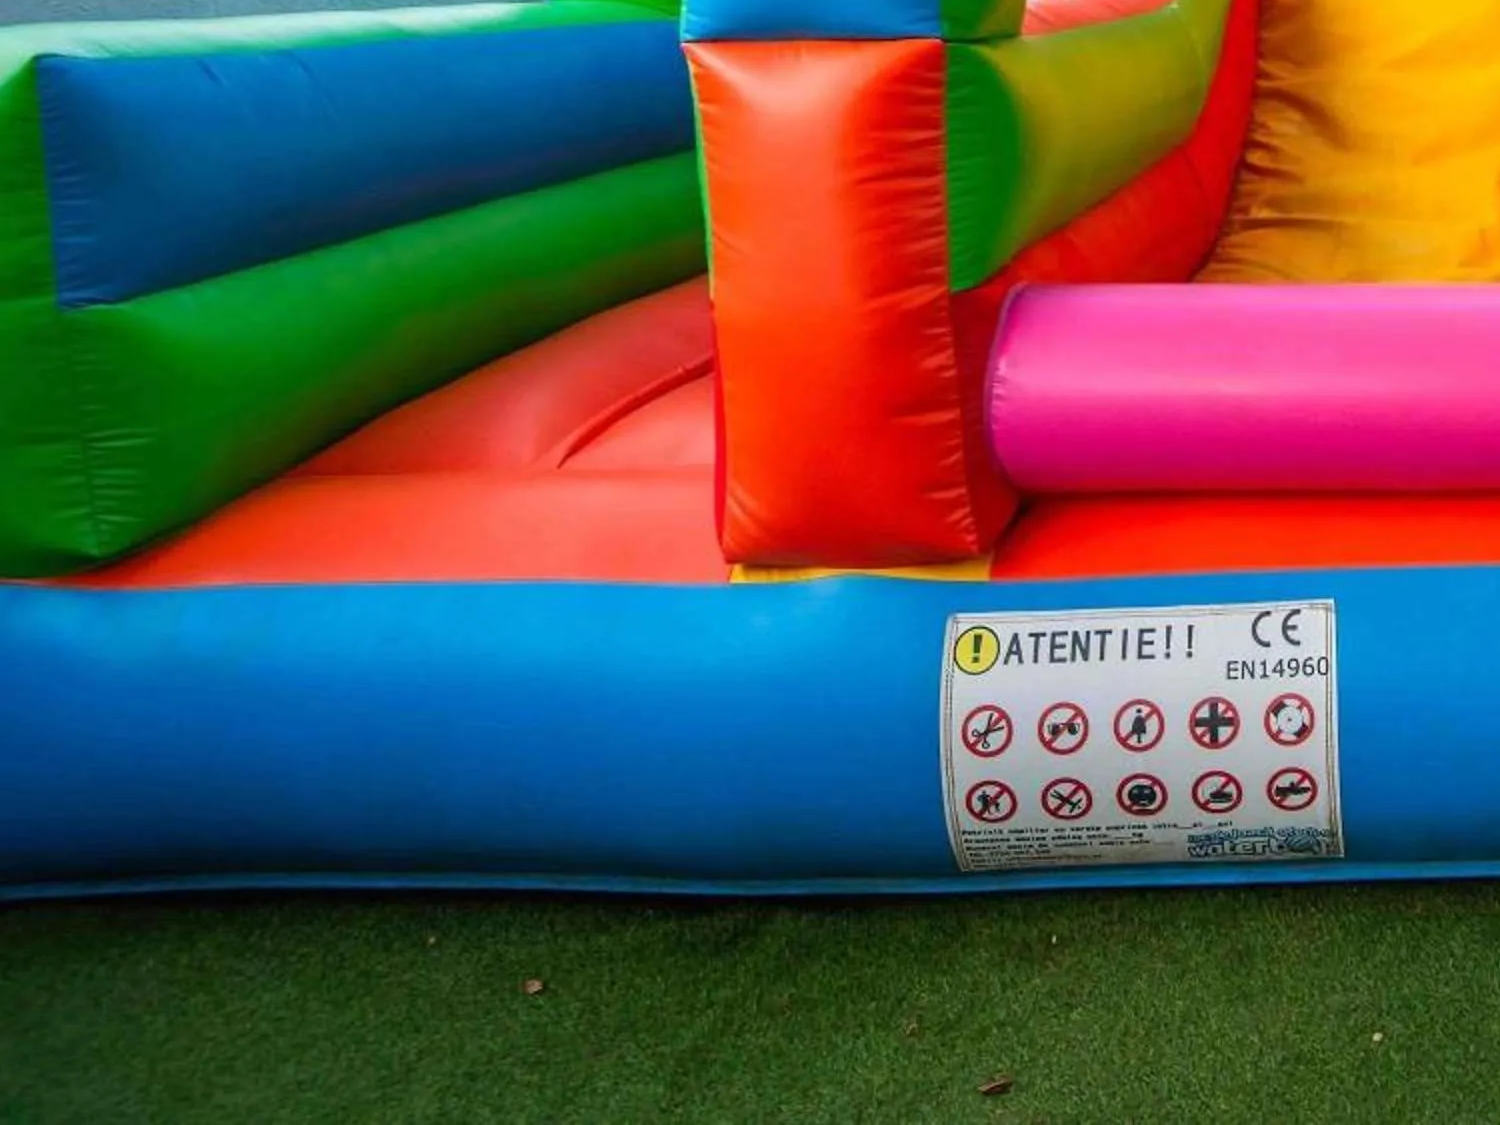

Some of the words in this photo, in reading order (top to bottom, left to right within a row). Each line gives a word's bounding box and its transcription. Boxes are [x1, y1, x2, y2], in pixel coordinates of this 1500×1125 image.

[1003, 624, 1195, 666] ATENTIE!!
[1251, 608, 1301, 648] CE
[1226, 655, 1330, 682] EN14960
